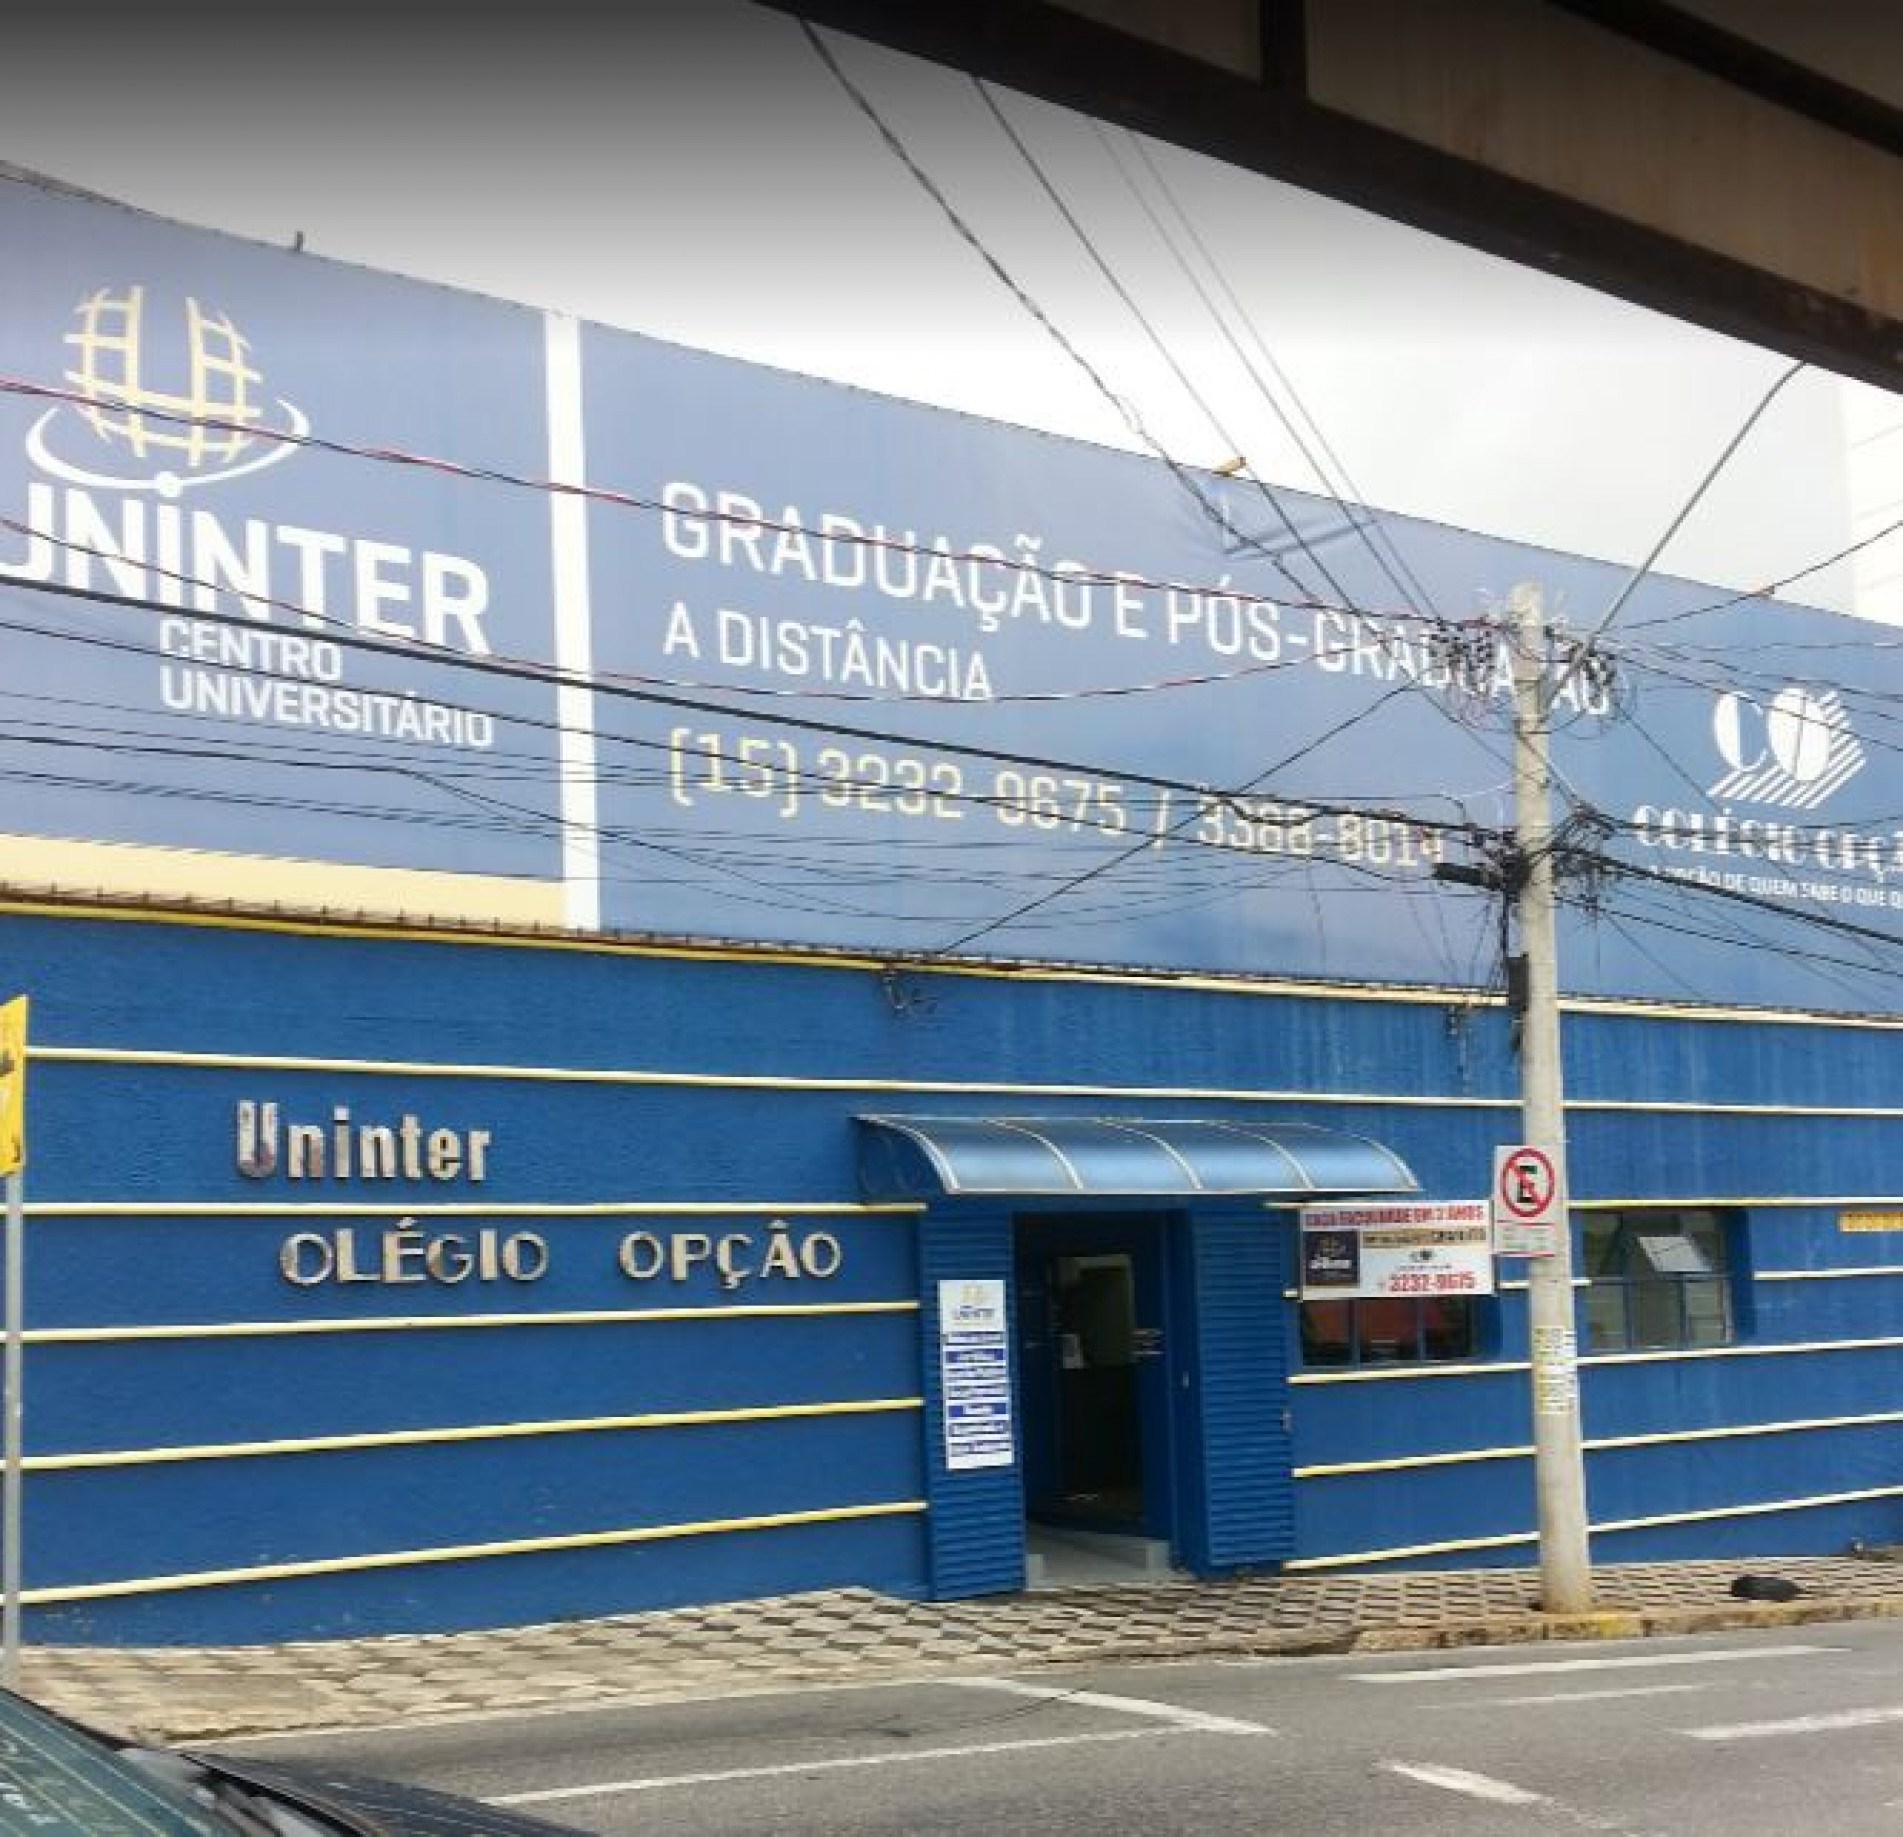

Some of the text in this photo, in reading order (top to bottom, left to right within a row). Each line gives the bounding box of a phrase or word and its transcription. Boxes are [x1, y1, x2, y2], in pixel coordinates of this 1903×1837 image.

[662, 481, 1093, 633] GRADUAÇÃO
[1114, 571, 1149, 639] E
[159, 619, 343, 683] CENTRO
[662, 602, 994, 700] A DISTÂNCIA
[159, 665, 495, 749] UNIVERSITÁRIO
[670, 727, 799, 819] (15)
[236, 1099, 493, 1182] Uninter
[279, 1217, 844, 1289] OLÉGIO OPÇÃO
